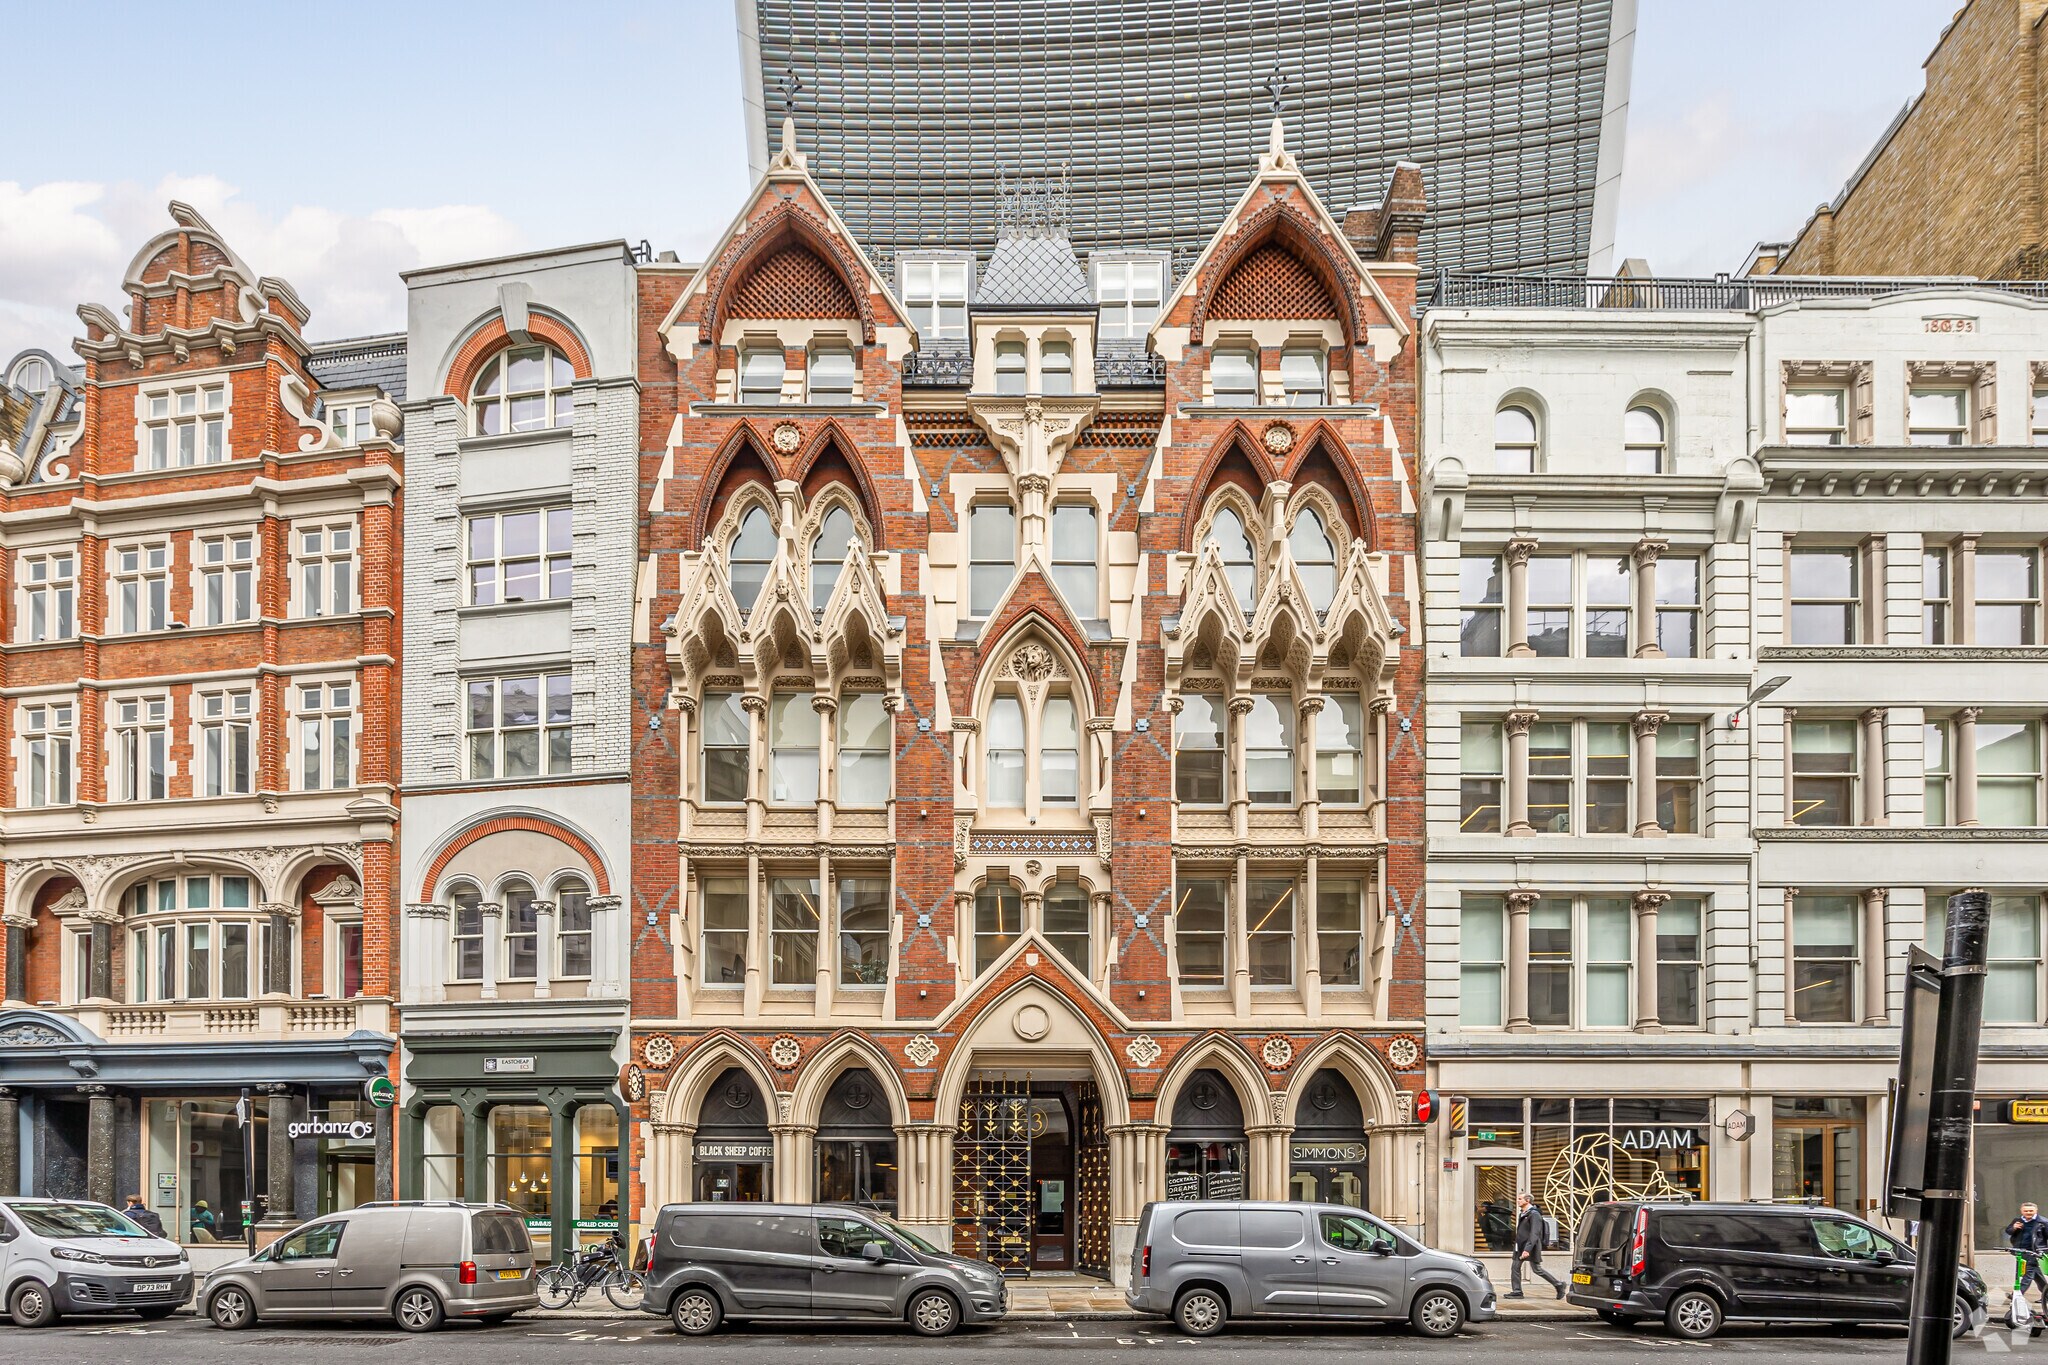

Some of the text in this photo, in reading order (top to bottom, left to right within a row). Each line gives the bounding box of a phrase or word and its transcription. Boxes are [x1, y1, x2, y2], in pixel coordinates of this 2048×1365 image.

[288, 1115, 374, 1139] garbanzos
[1727, 1121, 1746, 1130] ADAM
[1622, 1129, 1692, 1150] ADAM
[699, 1145, 723, 1157] BLACK
[724, 1145, 747, 1157] SHEEP
[1293, 1147, 1356, 1159] SIMMONS
[1168, 1175, 1198, 1185] COCKTAILS
[1168, 1185, 1198, 1194] DREAMS
[136, 1284, 155, 1292] DP73
